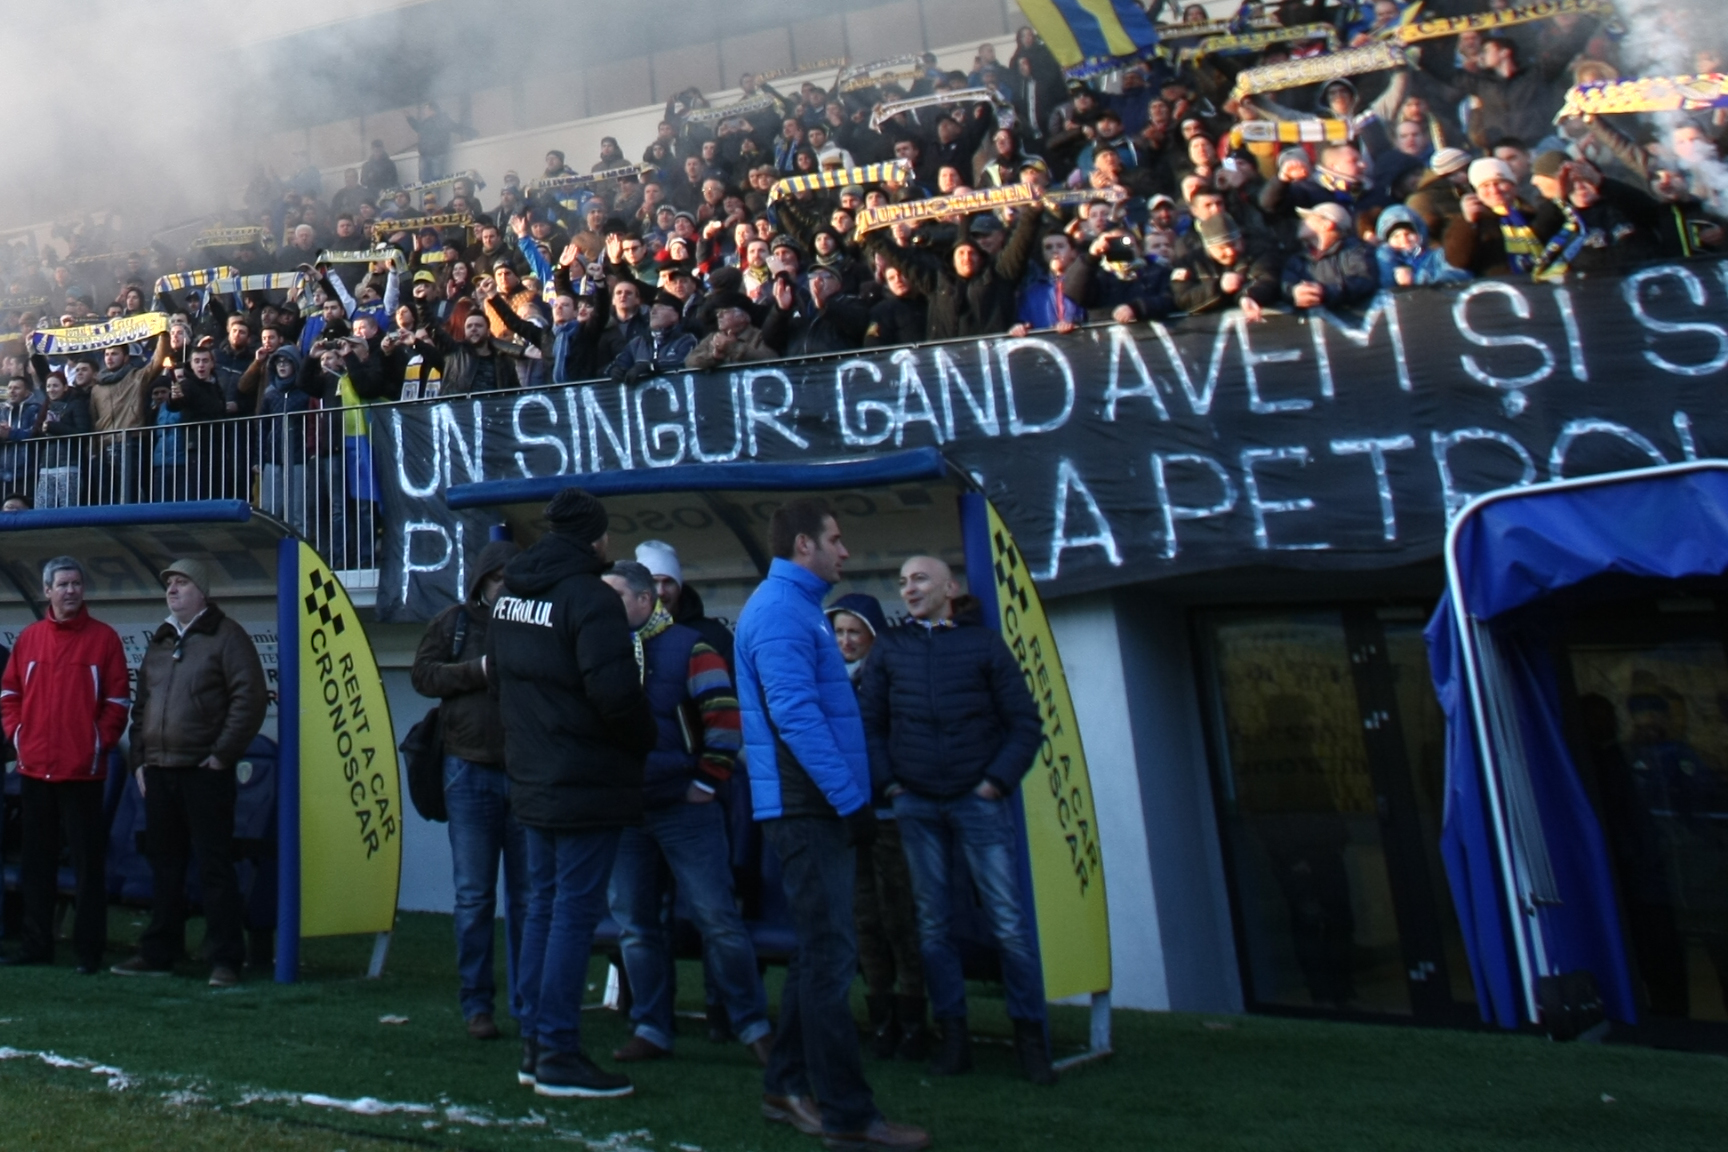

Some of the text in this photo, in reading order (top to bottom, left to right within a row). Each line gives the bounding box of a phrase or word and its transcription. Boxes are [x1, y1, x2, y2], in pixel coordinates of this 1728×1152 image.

[392, 398, 484, 498] UN
[513, 367, 808, 479] SINGUR
[836, 336, 1075, 447] GÂND
[1103, 288, 1413, 422] AVEM
[492, 596, 553, 627] PETROLUL
[311, 628, 380, 860] CRONOSCAR
[339, 652, 396, 843] RENT A CAR
[1005, 604, 1089, 898] CROOSCAR
[1029, 635, 1098, 874] RENT A CAR
